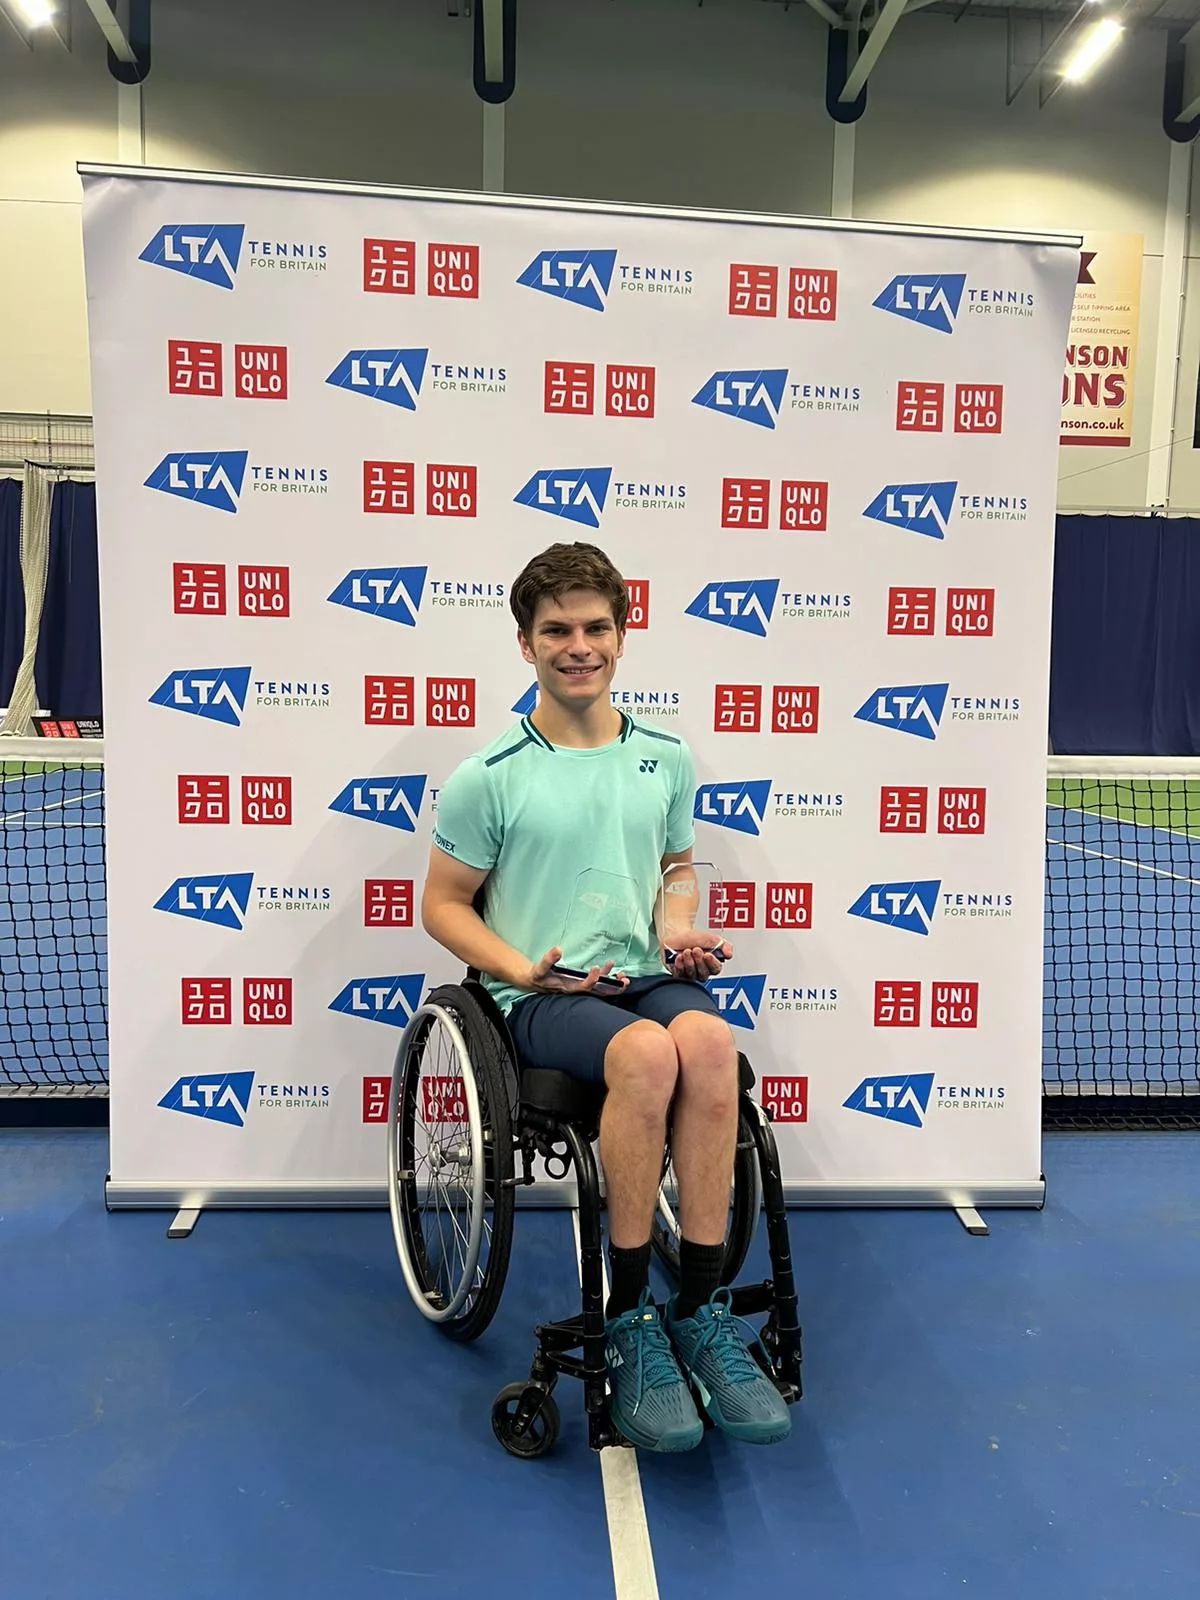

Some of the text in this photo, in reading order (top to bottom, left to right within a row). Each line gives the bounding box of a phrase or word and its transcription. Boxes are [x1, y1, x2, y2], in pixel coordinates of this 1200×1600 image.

[164, 235, 235, 279] LTA
[248, 241, 326, 258] TENNIS
[371, 246, 408, 265] ユニ
[251, 258, 326, 270] FOR BRITAIN
[434, 250, 469, 270] UNI
[370, 269, 408, 287] クロ
[541, 261, 608, 302] LTA
[620, 266, 692, 282] TENNIS
[736, 271, 771, 289] ユニ
[434, 272, 472, 293] QLO
[621, 282, 691, 294] FOR BRITAIN
[795, 275, 828, 293] UNI
[735, 292, 770, 310] クロ
[895, 285, 957, 324] LTA
[968, 289, 1034, 306] TENNIS
[794, 296, 831, 316] QLO
[968, 305, 1033, 317] FOR BRITAIN
[1099, 327, 1131, 335] RECYCLING
[176, 348, 214, 367] ユニ
[241, 352, 277, 370] UNI
[175, 370, 215, 389] クロ
[351, 360, 419, 401] LTA
[432, 365, 506, 380] TENNIS
[552, 368, 587, 386] ユニ
[242, 374, 281, 394] QLO
[433, 381, 505, 392] FOR BRITAIN
[612, 372, 646, 390] UNI
[550, 390, 587, 408] クロ
[791, 385, 860, 400] TENNIS
[904, 388, 937, 405] ユニ
[961, 390, 994, 407] UNI
[612, 393, 648, 413] QLO
[715, 381, 779, 421] LTA
[792, 400, 859, 411] FOR BRITAIN
[902, 409, 937, 425] クロ
[960, 410, 996, 429] QLO
[253, 467, 327, 481] TENNIS
[371, 468, 407, 486] ユニ
[433, 471, 467, 489] UNI
[169, 463, 238, 504] LTA
[254, 483, 327, 493] FOR BRITAIN
[615, 483, 685, 497] TENNIS
[369, 490, 407, 507] クロ
[538, 480, 604, 519] LTA
[729, 485, 763, 502] ユニ
[787, 487, 819, 504] UNI
[433, 492, 470, 512] QLO
[616, 499, 685, 509] FOR BRITAIN
[960, 496, 1026, 510] TENNIS
[727, 506, 762, 522] クロ
[786, 507, 821, 527] QLO
[885, 494, 948, 531] LTA
[961, 511, 1026, 520] FOR BRITAIN
[181, 570, 218, 587] ユニ
[245, 572, 279, 590] UNI
[431, 582, 504, 595] TENNIS
[180, 592, 219, 608] クロ
[245, 593, 283, 613] QLO
[352, 579, 418, 618] LTA
[432, 597, 503, 607] FOR BRITAIN
[782, 594, 850, 606] TENNIS
[895, 594, 929, 609] ユニ
[953, 595, 985, 610] UNI
[708, 592, 770, 629] LTA
[808, 609, 849, 618] BRITAIN
[893, 614, 928, 629] クロ
[952, 614, 988, 632] QLO
[255, 682, 329, 695] TENNIS
[372, 682, 407, 698] ユニ
[432, 684, 466, 701] UNI
[174, 680, 243, 718] LTA
[257, 697, 329, 707] FOR BRITAIN
[610, 691, 679, 704] TENNIS
[721, 691, 755, 706] ユニ
[778, 692, 810, 708] UNI
[951, 698, 1019, 710] TENNIS
[371, 703, 407, 719] クロ
[432, 704, 469, 723] QLO
[637, 707, 678, 715] BRITAIN
[720, 711, 754, 726] クロ
[877, 697, 940, 732] LTA
[952, 712, 1018, 720] FOR BRITAIN
[777, 711, 812, 730] QLO
[186, 782, 222, 797] ユニ
[248, 782, 282, 799] UNI
[353, 788, 417, 824] LTA
[774, 794, 842, 805] TENNIS
[887, 793, 920, 808] ユニ
[944, 794, 977, 809] UNI
[184, 802, 222, 817] クロ
[248, 802, 286, 821] QLO
[702, 793, 763, 827] LTA
[775, 808, 796, 816] FOR
[885, 812, 920, 827] クロ
[944, 813, 979, 831] QLO
[257, 887, 330, 899] TENNIS
[372, 886, 406, 901] ユニ
[772, 889, 803, 904] UNI
[943, 894, 1012, 906] TENNIS
[178, 887, 246, 922] LTA
[259, 902, 329, 910] FOR BRITAIN
[870, 893, 933, 927] LTA
[945, 908, 966, 916] FOR
[370, 906, 406, 920] クロ
[772, 908, 806, 925] QLO
[189, 984, 224, 999] ユニ
[249, 984, 282, 999] UNI
[769, 988, 837, 1000] TENNIS
[881, 987, 914, 1002] ユニ
[938, 988, 969, 1003] UNI
[188, 1004, 224, 1018] クロ
[249, 1003, 286, 1021] QLO
[770, 1002, 791, 1010] FOR
[879, 1006, 914, 1021] クロ
[937, 1007, 972, 1024] QLO
[258, 1085, 329, 1096] TENNIS
[768, 1083, 799, 1097] UNI
[937, 1087, 1004, 1098] TENNIS
[181, 1085, 247, 1119] LTA
[260, 1099, 281, 1107] FOR
[865, 1086, 926, 1120] LTA
